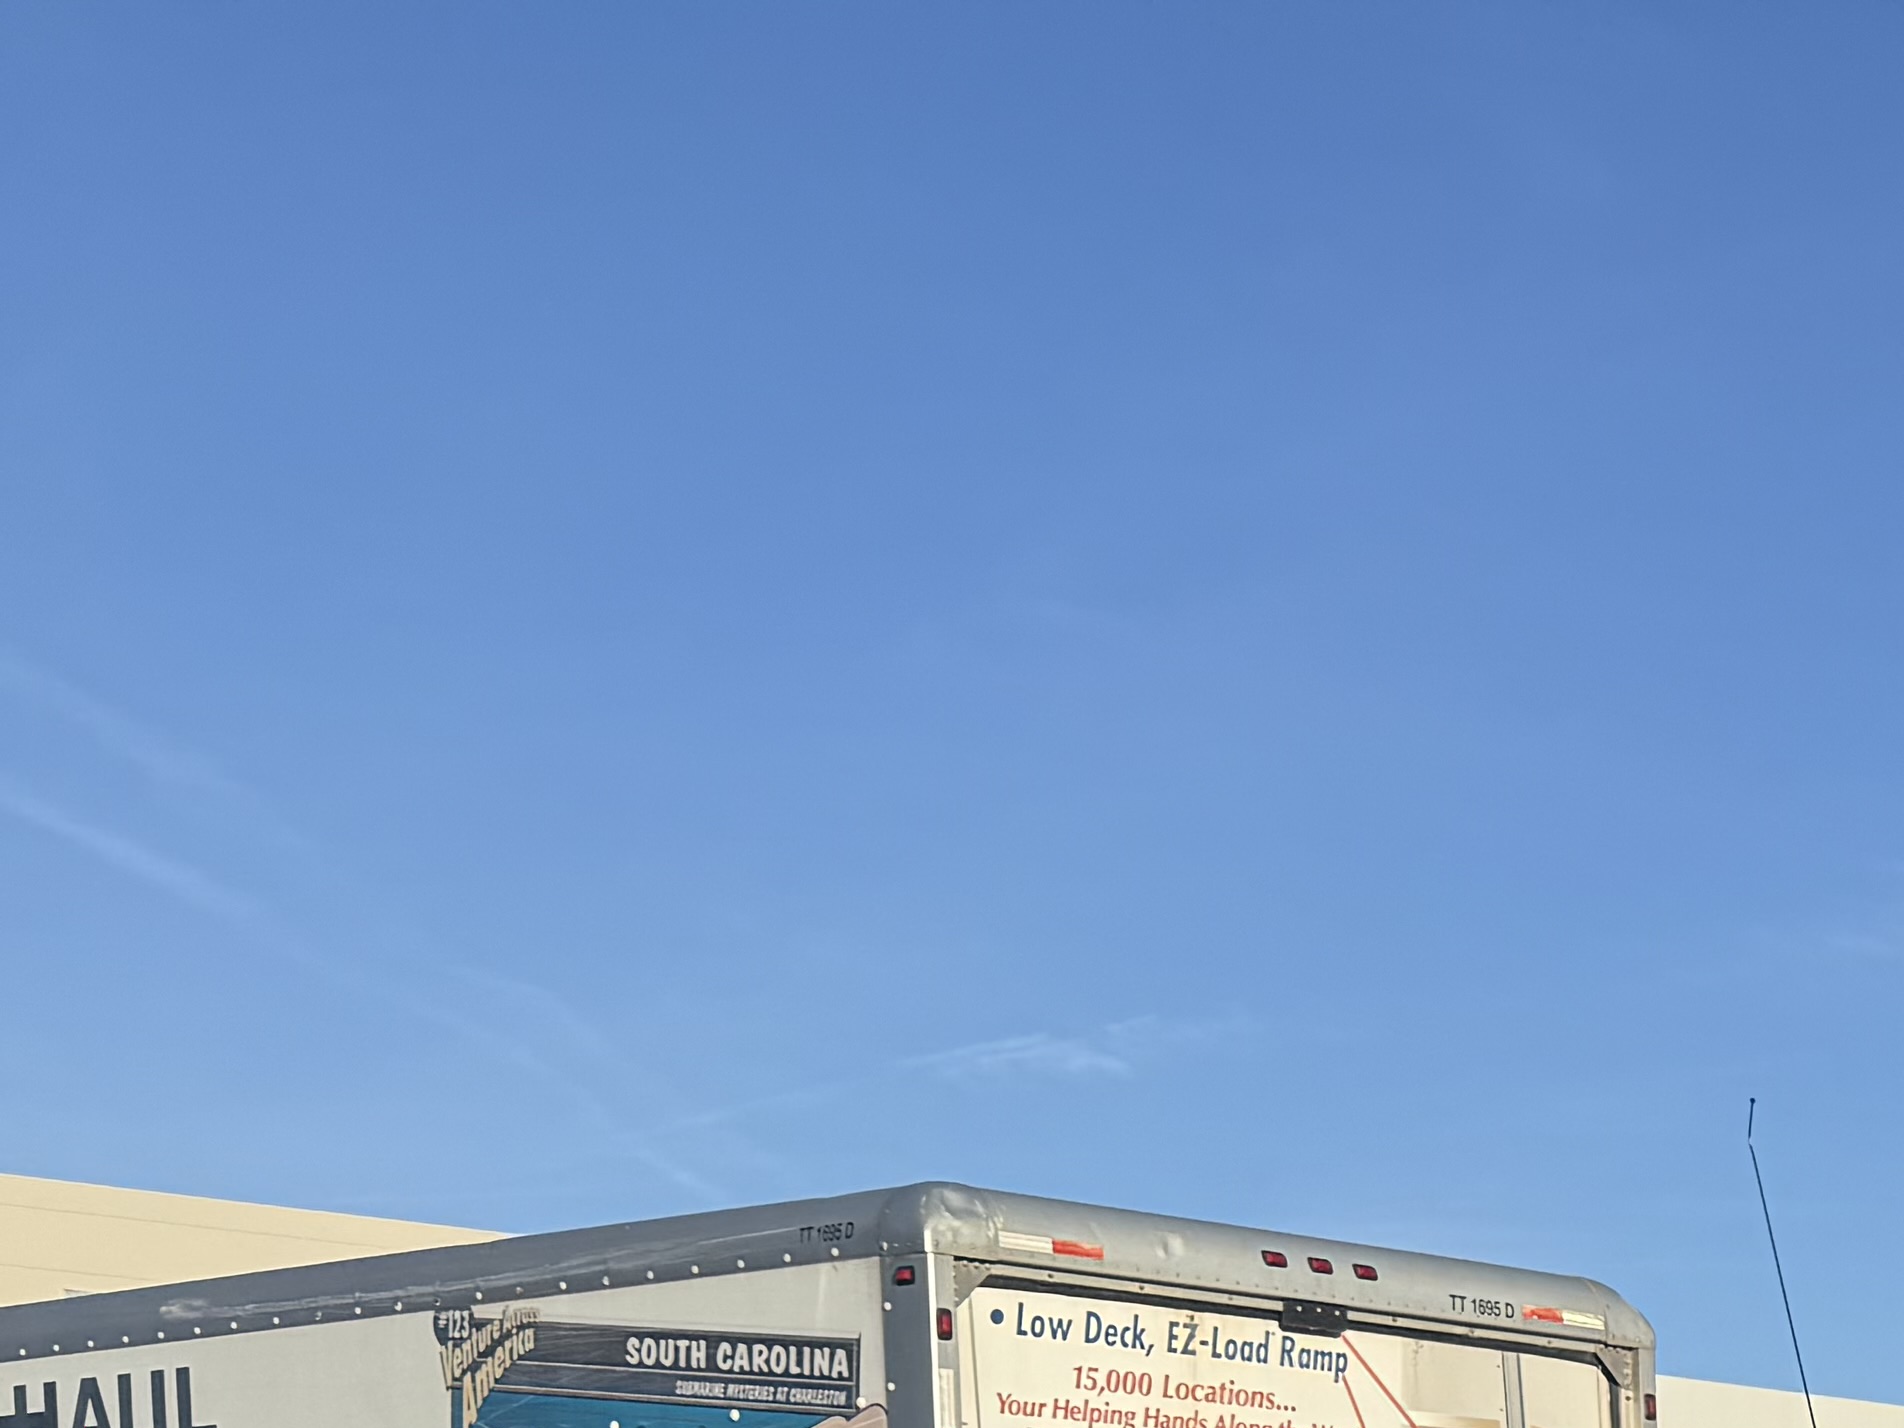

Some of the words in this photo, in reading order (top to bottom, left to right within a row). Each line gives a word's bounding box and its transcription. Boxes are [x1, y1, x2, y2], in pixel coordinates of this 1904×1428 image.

[1449, 1294, 1467, 1312] TT
[1471, 1298, 1502, 1317] 1695
[1505, 1302, 1515, 1319] D
[439, 1319, 501, 1389] Venture
[625, 1336, 707, 1369] SOUTH
[716, 1341, 849, 1378] CAROLINA
[1016, 1302, 1072, 1340] Low
[1084, 1310, 1155, 1356] Deck,
[1167, 1319, 1270, 1365] EZ-Load
[1280, 1335, 1348, 1383] Ramp
[996, 1392, 1047, 1419] Your
[1073, 1366, 1152, 1397] 15,000
[1162, 1374, 1297, 1412] Locations...
